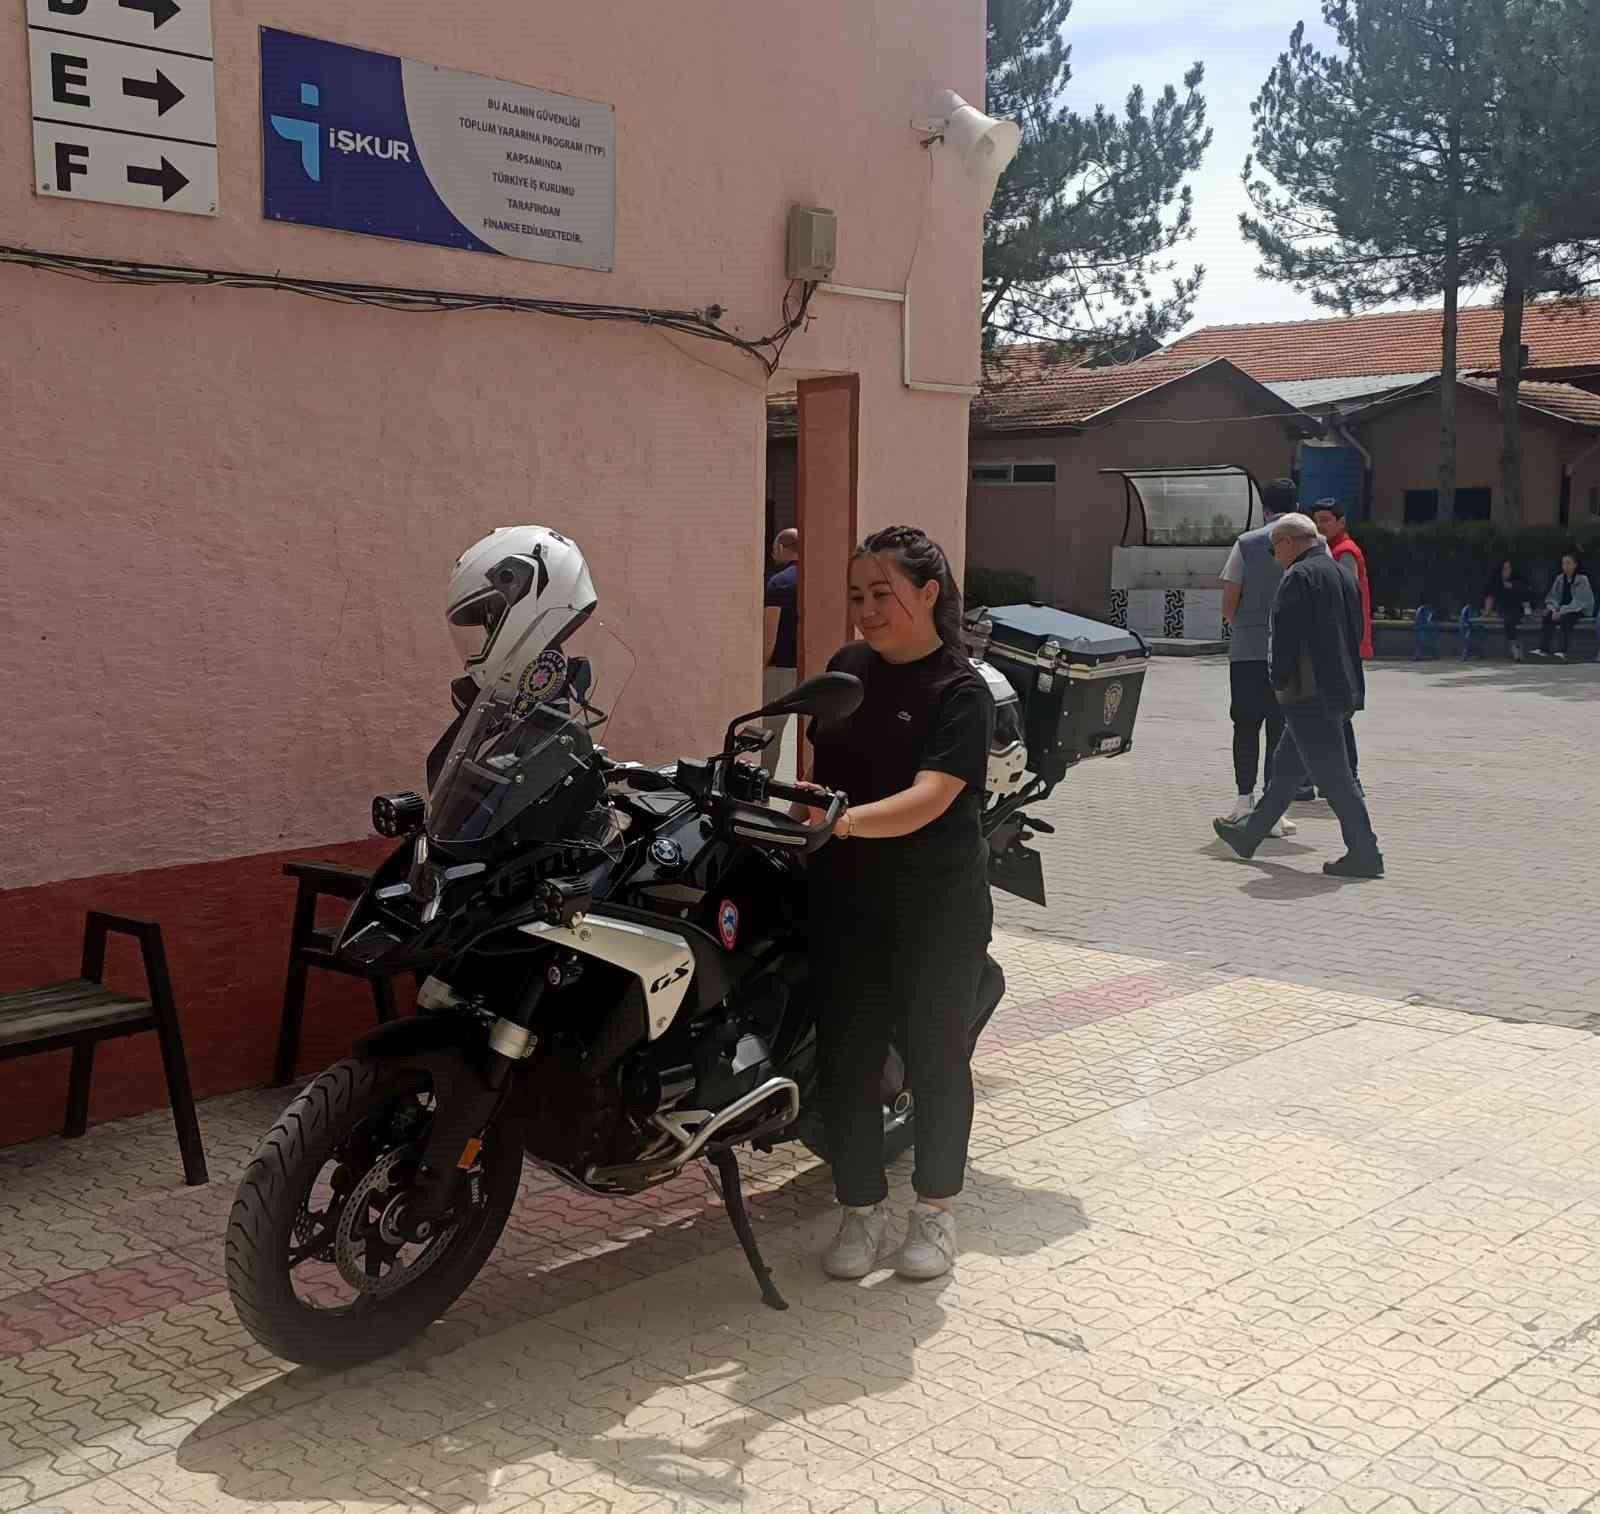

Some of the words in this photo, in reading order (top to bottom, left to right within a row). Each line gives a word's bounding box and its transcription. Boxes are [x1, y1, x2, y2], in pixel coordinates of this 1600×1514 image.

[51, 52, 90, 107] E
[487, 98, 501, 110] BU
[502, 102, 535, 118] ALANIN
[536, 108, 581, 129] GÜVENLİĞİ
[459, 117, 496, 133] TOPLUM
[497, 125, 540, 143] YARARINA
[542, 135, 583, 152] PROGRAM
[584, 144, 606, 158] (TYP)
[55, 142, 90, 192] F
[506, 151, 562, 171] KAPSAMINDA
[492, 170, 529, 187] TÜRKİYE
[530, 177, 538, 192] İŞ
[539, 179, 575, 197] KURUMU
[507, 198, 561, 217] TARAFINDAN
[483, 217, 521, 234] FİNANSE
[650, 960, 690, 994] GS
